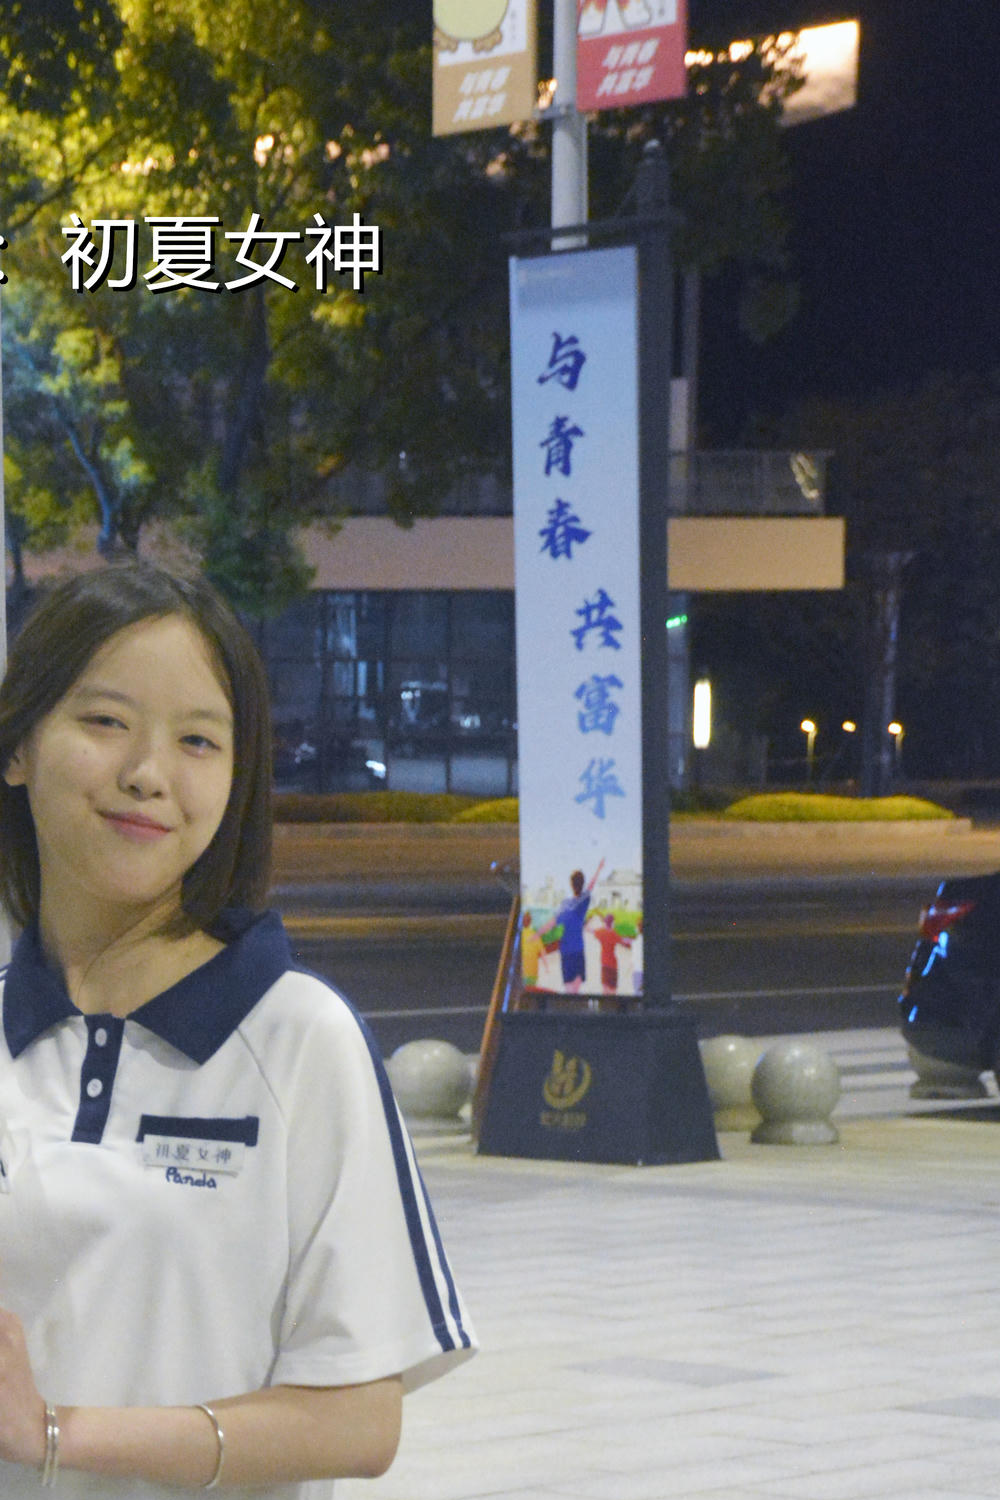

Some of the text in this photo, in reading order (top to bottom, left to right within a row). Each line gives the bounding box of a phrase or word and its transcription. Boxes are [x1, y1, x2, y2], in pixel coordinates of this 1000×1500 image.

[537, 331, 592, 561] 与青春
[570, 587, 626, 820] 共富华
[165, 1166, 217, 1188] Panda
